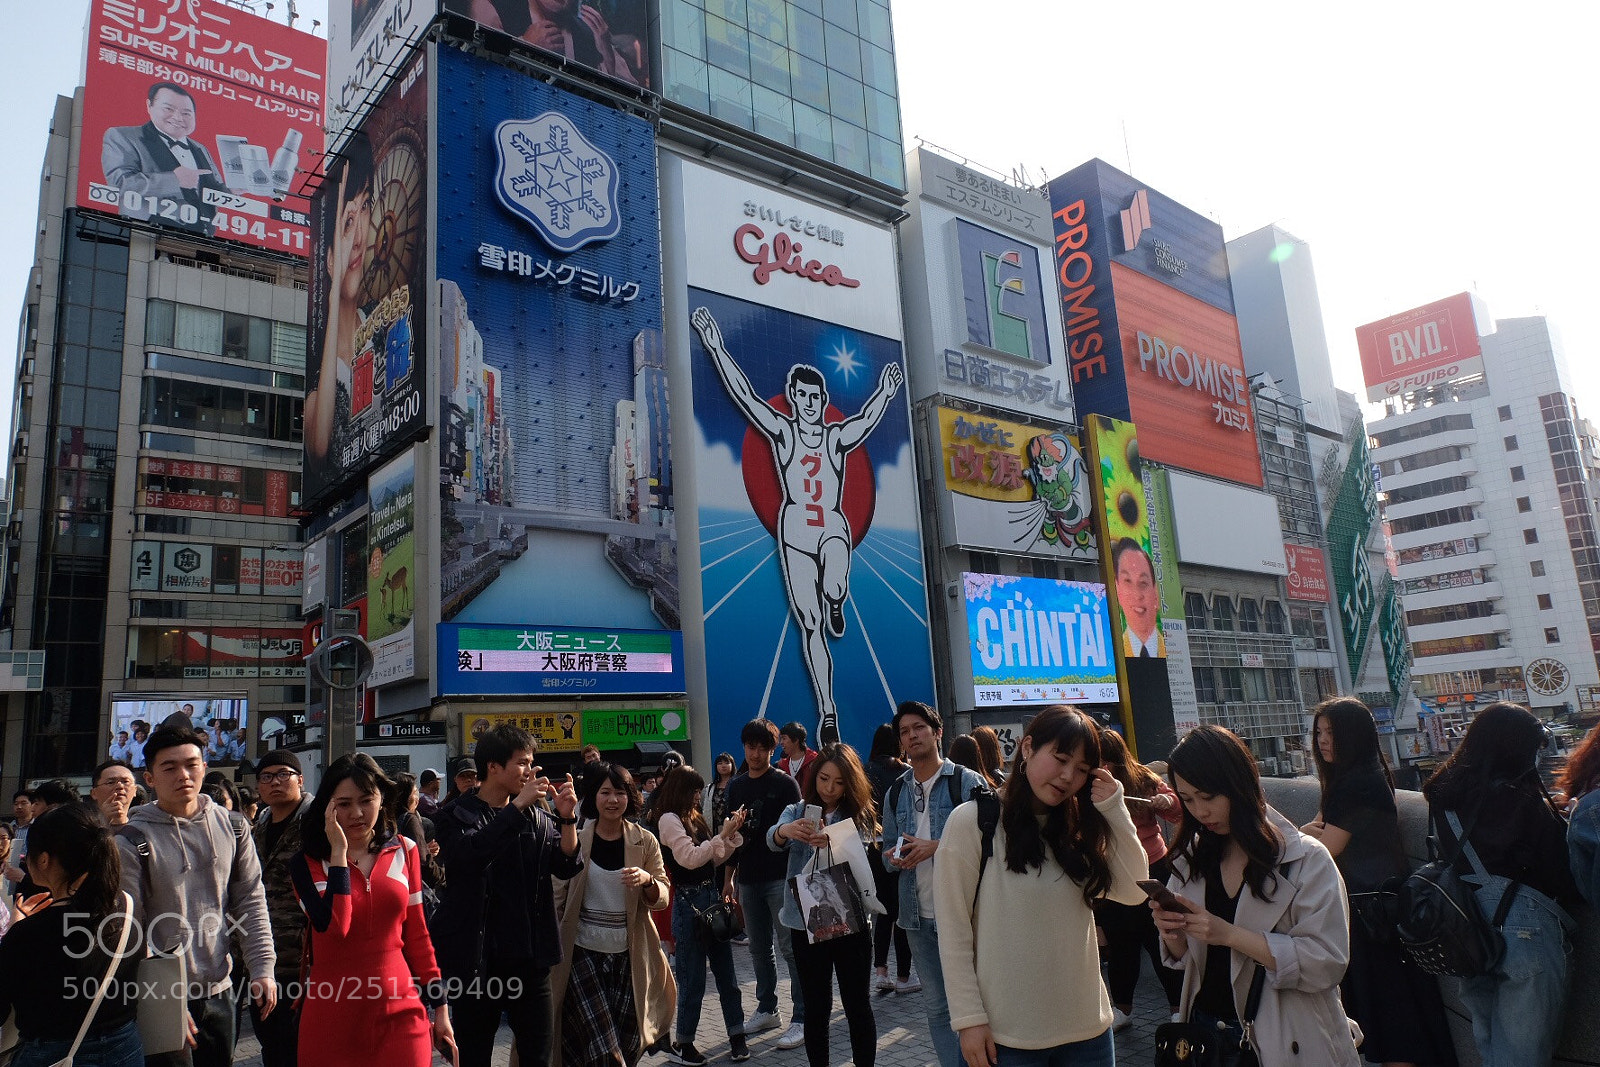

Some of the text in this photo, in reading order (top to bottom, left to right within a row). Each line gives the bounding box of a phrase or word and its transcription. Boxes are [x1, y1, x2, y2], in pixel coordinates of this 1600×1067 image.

[102, 2, 321, 80] ミリオンヘアー
[100, 25, 320, 105] SUPER MILLION HAIR
[206, 191, 247, 208] ルアン
[945, 184, 1036, 232] エステムシリーズ
[954, 167, 1022, 205] 夢ある住まい
[122, 190, 310, 249] 0120-494-11
[743, 200, 844, 247] おいしさと健康
[477, 243, 640, 301] 雪印メグミルク
[734, 223, 861, 285] Glico
[1052, 198, 1108, 385] PROMISE
[1388, 321, 1449, 367] B.V.D.
[944, 348, 1074, 412] 日商エステム
[1136, 330, 1248, 406] PROMISE
[1402, 365, 1460, 390] FUJIBO
[953, 415, 1015, 448] かぜに
[1212, 401, 1251, 433] プロミス
[799, 451, 825, 528] グリコ
[951, 444, 1025, 490] 改源
[146, 492, 164, 506] 5F
[370, 500, 390, 526] Travel
[395, 489, 413, 512] Nara
[376, 513, 407, 542] Kintetsu.
[516, 630, 622, 651] 大阪ニュース
[976, 590, 1108, 670] CHINTAI
[541, 652, 628, 671] 大阪府警察
[541, 678, 597, 688] 雪印メグミルク
[395, 725, 431, 735] Toilets
[617, 713, 658, 736] ピタットハウス
